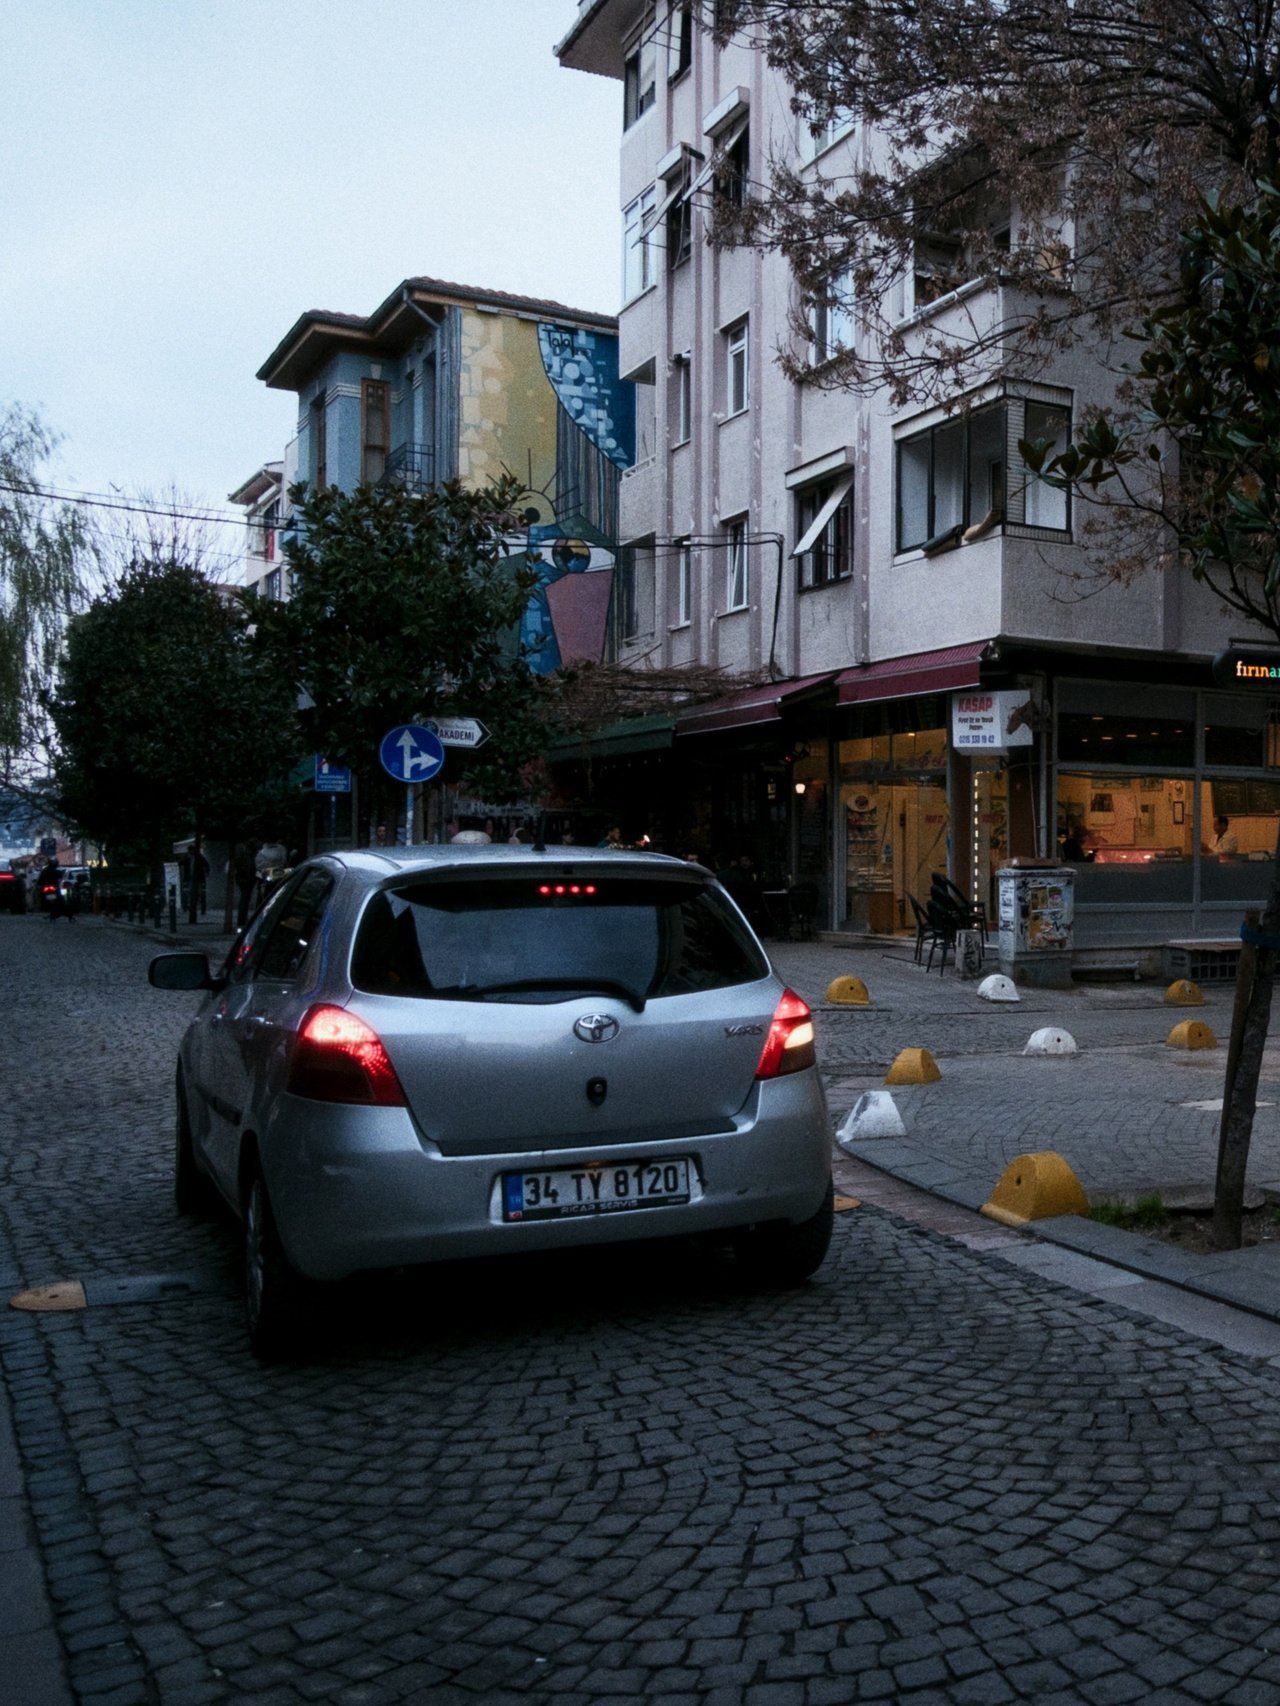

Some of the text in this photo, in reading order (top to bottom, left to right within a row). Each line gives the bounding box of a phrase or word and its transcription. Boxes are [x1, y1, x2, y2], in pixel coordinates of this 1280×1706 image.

[958, 696, 993, 713] KASAP
[525, 1165, 679, 1206] 34 TY 8120
